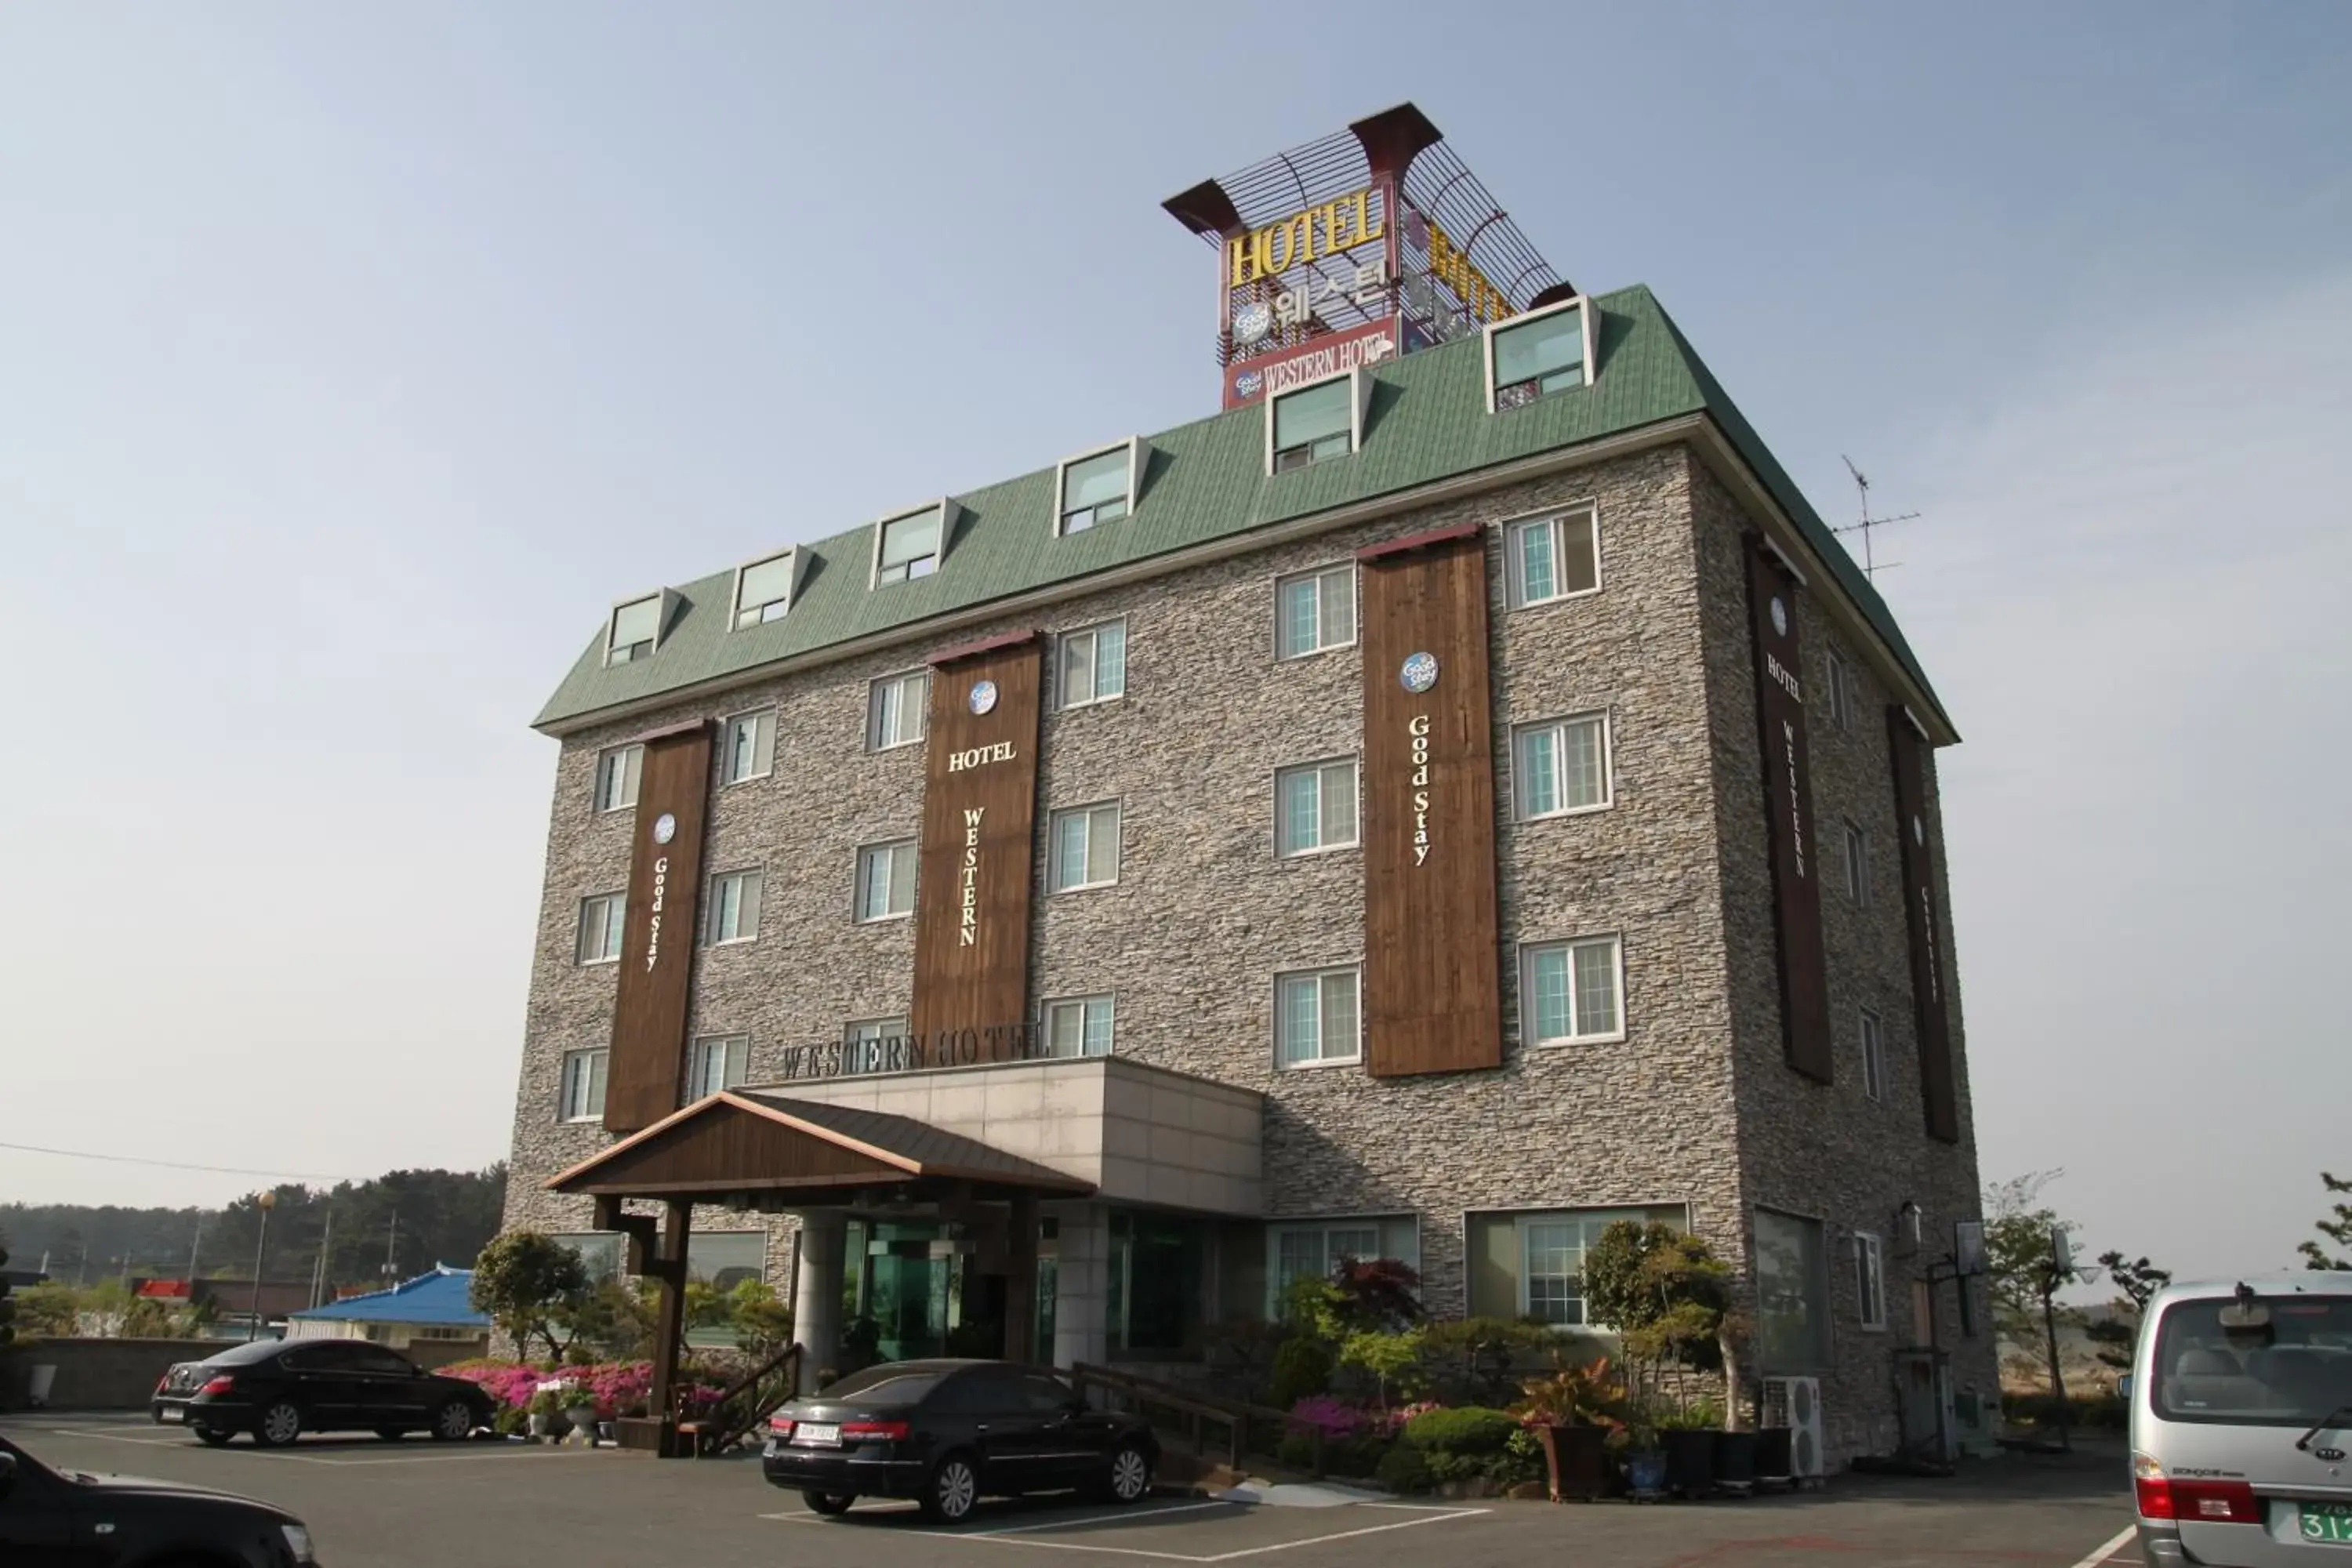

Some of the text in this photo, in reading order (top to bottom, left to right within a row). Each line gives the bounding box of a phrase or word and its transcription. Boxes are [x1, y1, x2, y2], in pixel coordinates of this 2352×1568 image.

[1229, 191, 1385, 288] HOTEL
[1276, 259, 1387, 328] 웨스턴
[1264, 346, 1335, 392] WESTERN
[1766, 652, 1802, 703] HOTEL
[948, 741, 1018, 772] HOTEL
[1409, 715, 1431, 867] Good Stay
[652, 856, 668, 913] Good
[959, 807, 985, 946] WESTERN
[647, 916, 662, 973] Stay
